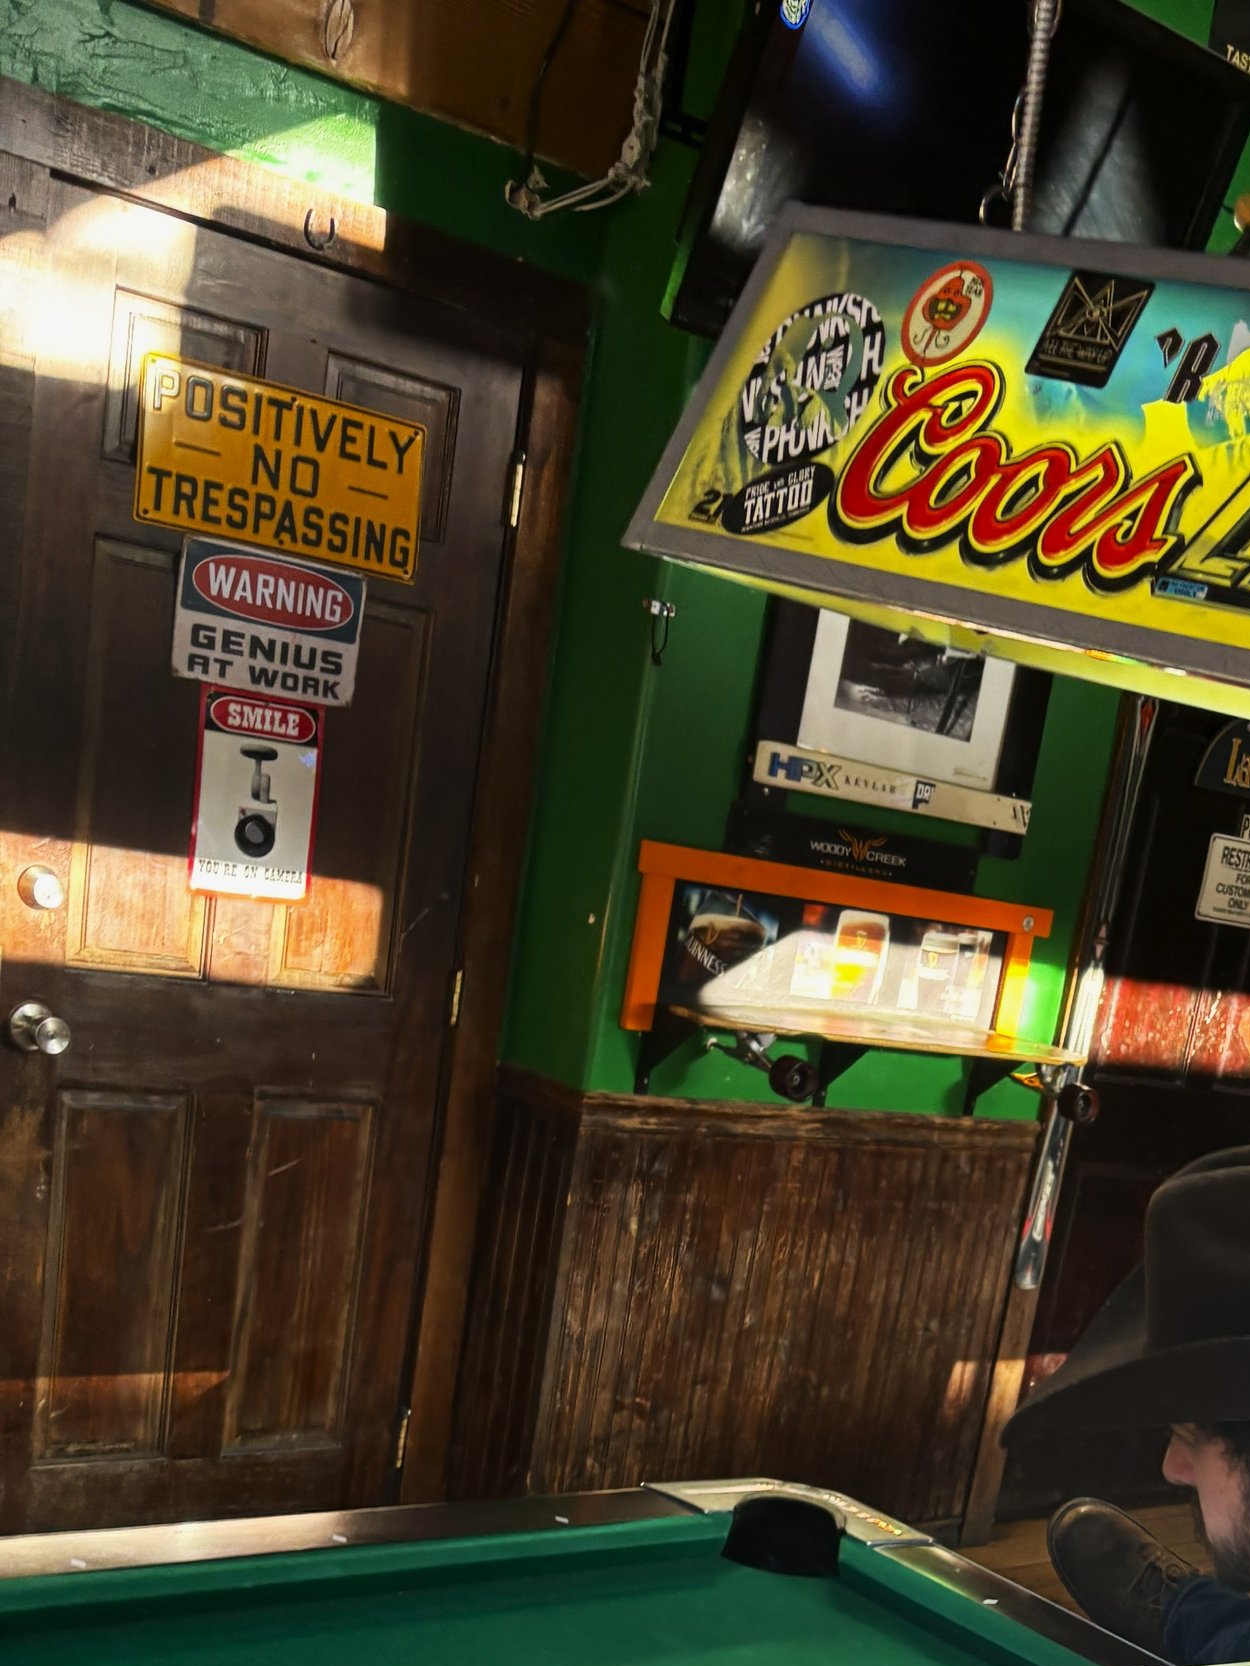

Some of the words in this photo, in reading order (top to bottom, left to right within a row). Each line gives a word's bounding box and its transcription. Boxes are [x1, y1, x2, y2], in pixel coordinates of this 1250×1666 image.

[153, 367, 416, 474] POSITIVELY
[252, 443, 319, 498] NO
[746, 480, 771, 499] PRIDE
[788, 465, 816, 487] GLORY
[829, 360, 1202, 596] Coors
[147, 465, 411, 568] TRESPASSING
[744, 480, 814, 526] TATTOO
[208, 562, 343, 623] WARNING
[190, 623, 343, 676] GENIUS
[187, 653, 233, 678] AT
[249, 665, 341, 700] WORK
[227, 702, 300, 737] SMILE
[844, 775, 898, 795] KEVLAR
[199, 859, 238, 877] YOU'RE
[245, 866, 258, 878] ON
[265, 868, 303, 884] CAMERA
[810, 839, 852, 857] WOODY
[866, 851, 907, 868] CREEK
[1227, 898, 1250, 912] ONLY
[685, 934, 728, 976] UINNESS
